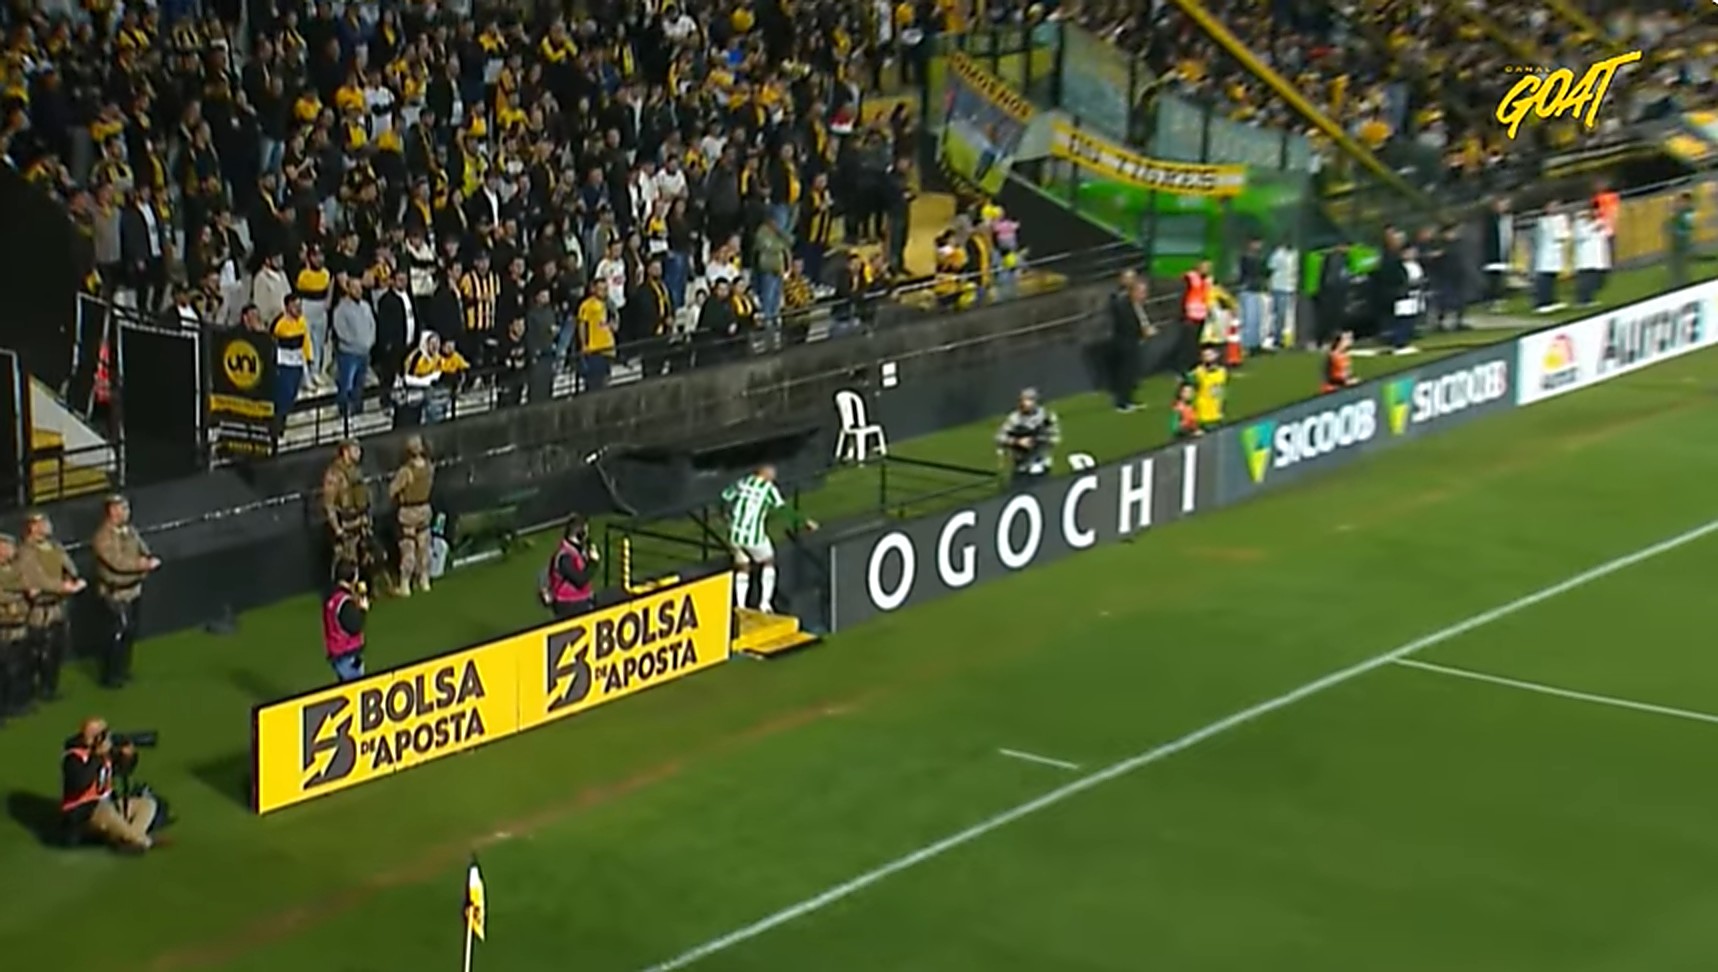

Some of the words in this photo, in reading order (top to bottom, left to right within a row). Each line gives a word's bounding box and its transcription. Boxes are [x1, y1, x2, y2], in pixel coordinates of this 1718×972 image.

[1411, 360, 1507, 423] SICOOB
[1273, 399, 1377, 463] SICOOB
[867, 445, 1197, 610] OGOCHI
[595, 593, 699, 660] BOLSA
[361, 659, 485, 733] BOLSA
[604, 638, 698, 694] APOSTA
[373, 706, 485, 770] APOSTA
